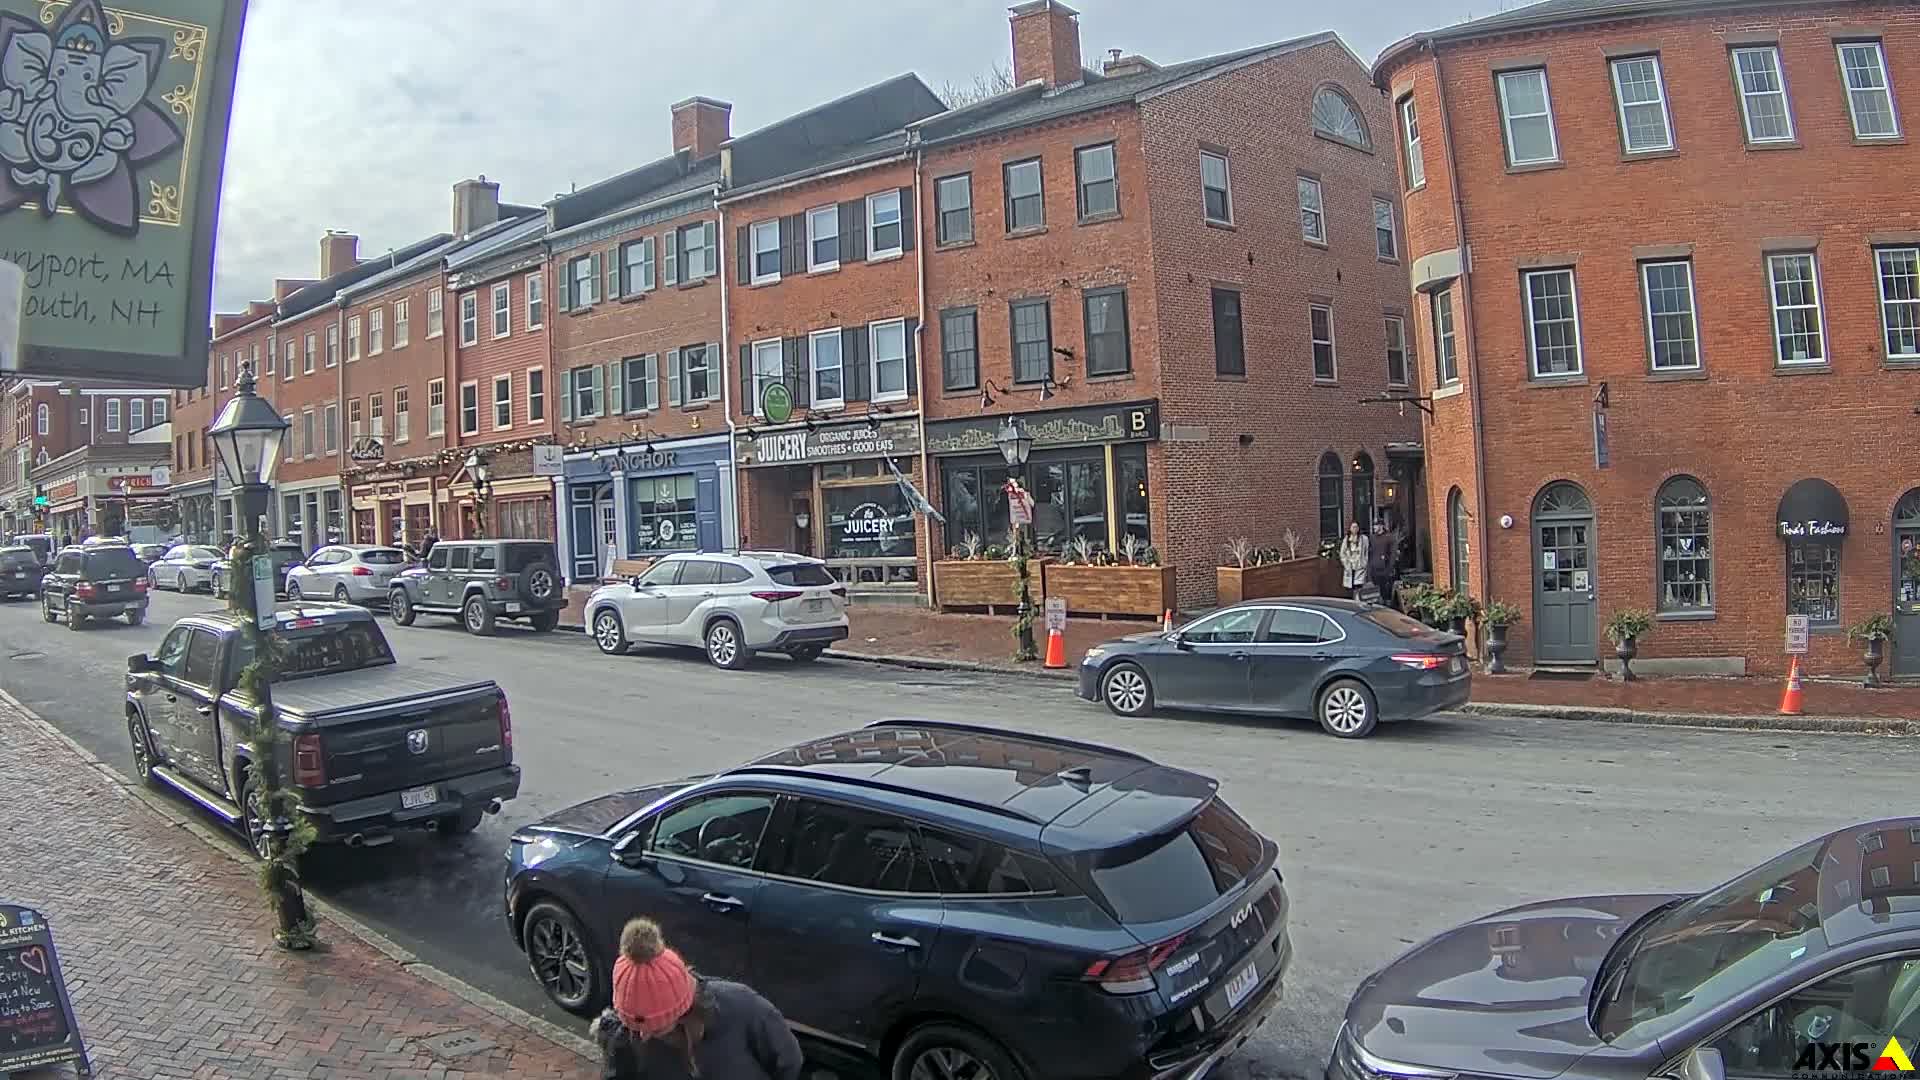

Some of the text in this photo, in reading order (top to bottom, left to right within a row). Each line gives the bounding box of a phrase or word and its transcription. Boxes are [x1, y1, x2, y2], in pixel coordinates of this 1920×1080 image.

[121, 258, 175, 288] MA
[25, 291, 164, 328] outh, NH
[1132, 411, 1145, 430] B
[819, 429, 878, 443] ORGANIC JUICES
[757, 433, 807, 462] JUICERY
[807, 439, 894, 457] SMOOTHIES GOOD EATS
[610, 451, 676, 471] ANCHOR
[844, 518, 895, 534] JUICERY
[1781, 520, 1846, 535] Tina's Fashions
[9, 924, 46, 936] KITCHEN
